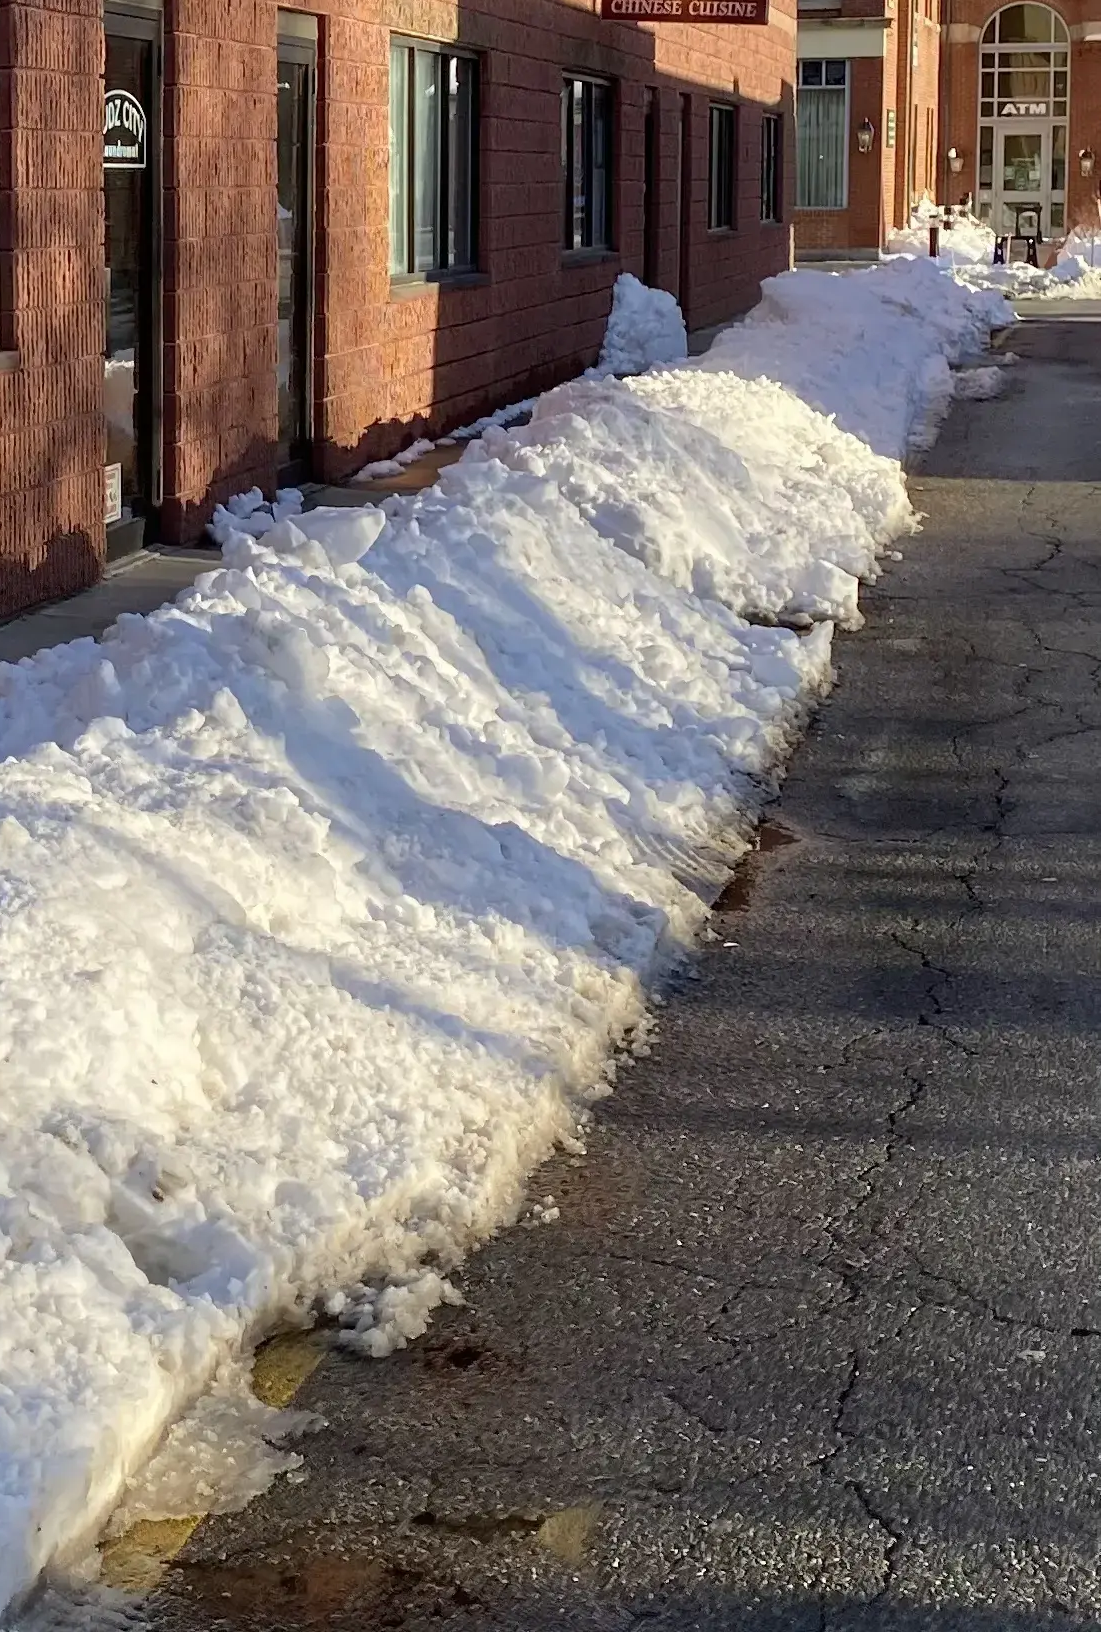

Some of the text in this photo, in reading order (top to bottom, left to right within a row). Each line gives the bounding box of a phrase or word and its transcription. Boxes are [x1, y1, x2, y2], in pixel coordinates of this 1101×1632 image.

[688, 0, 757, 17] CUISINE
[1000, 102, 1047, 116] ATM
[123, 100, 144, 143] CITY
